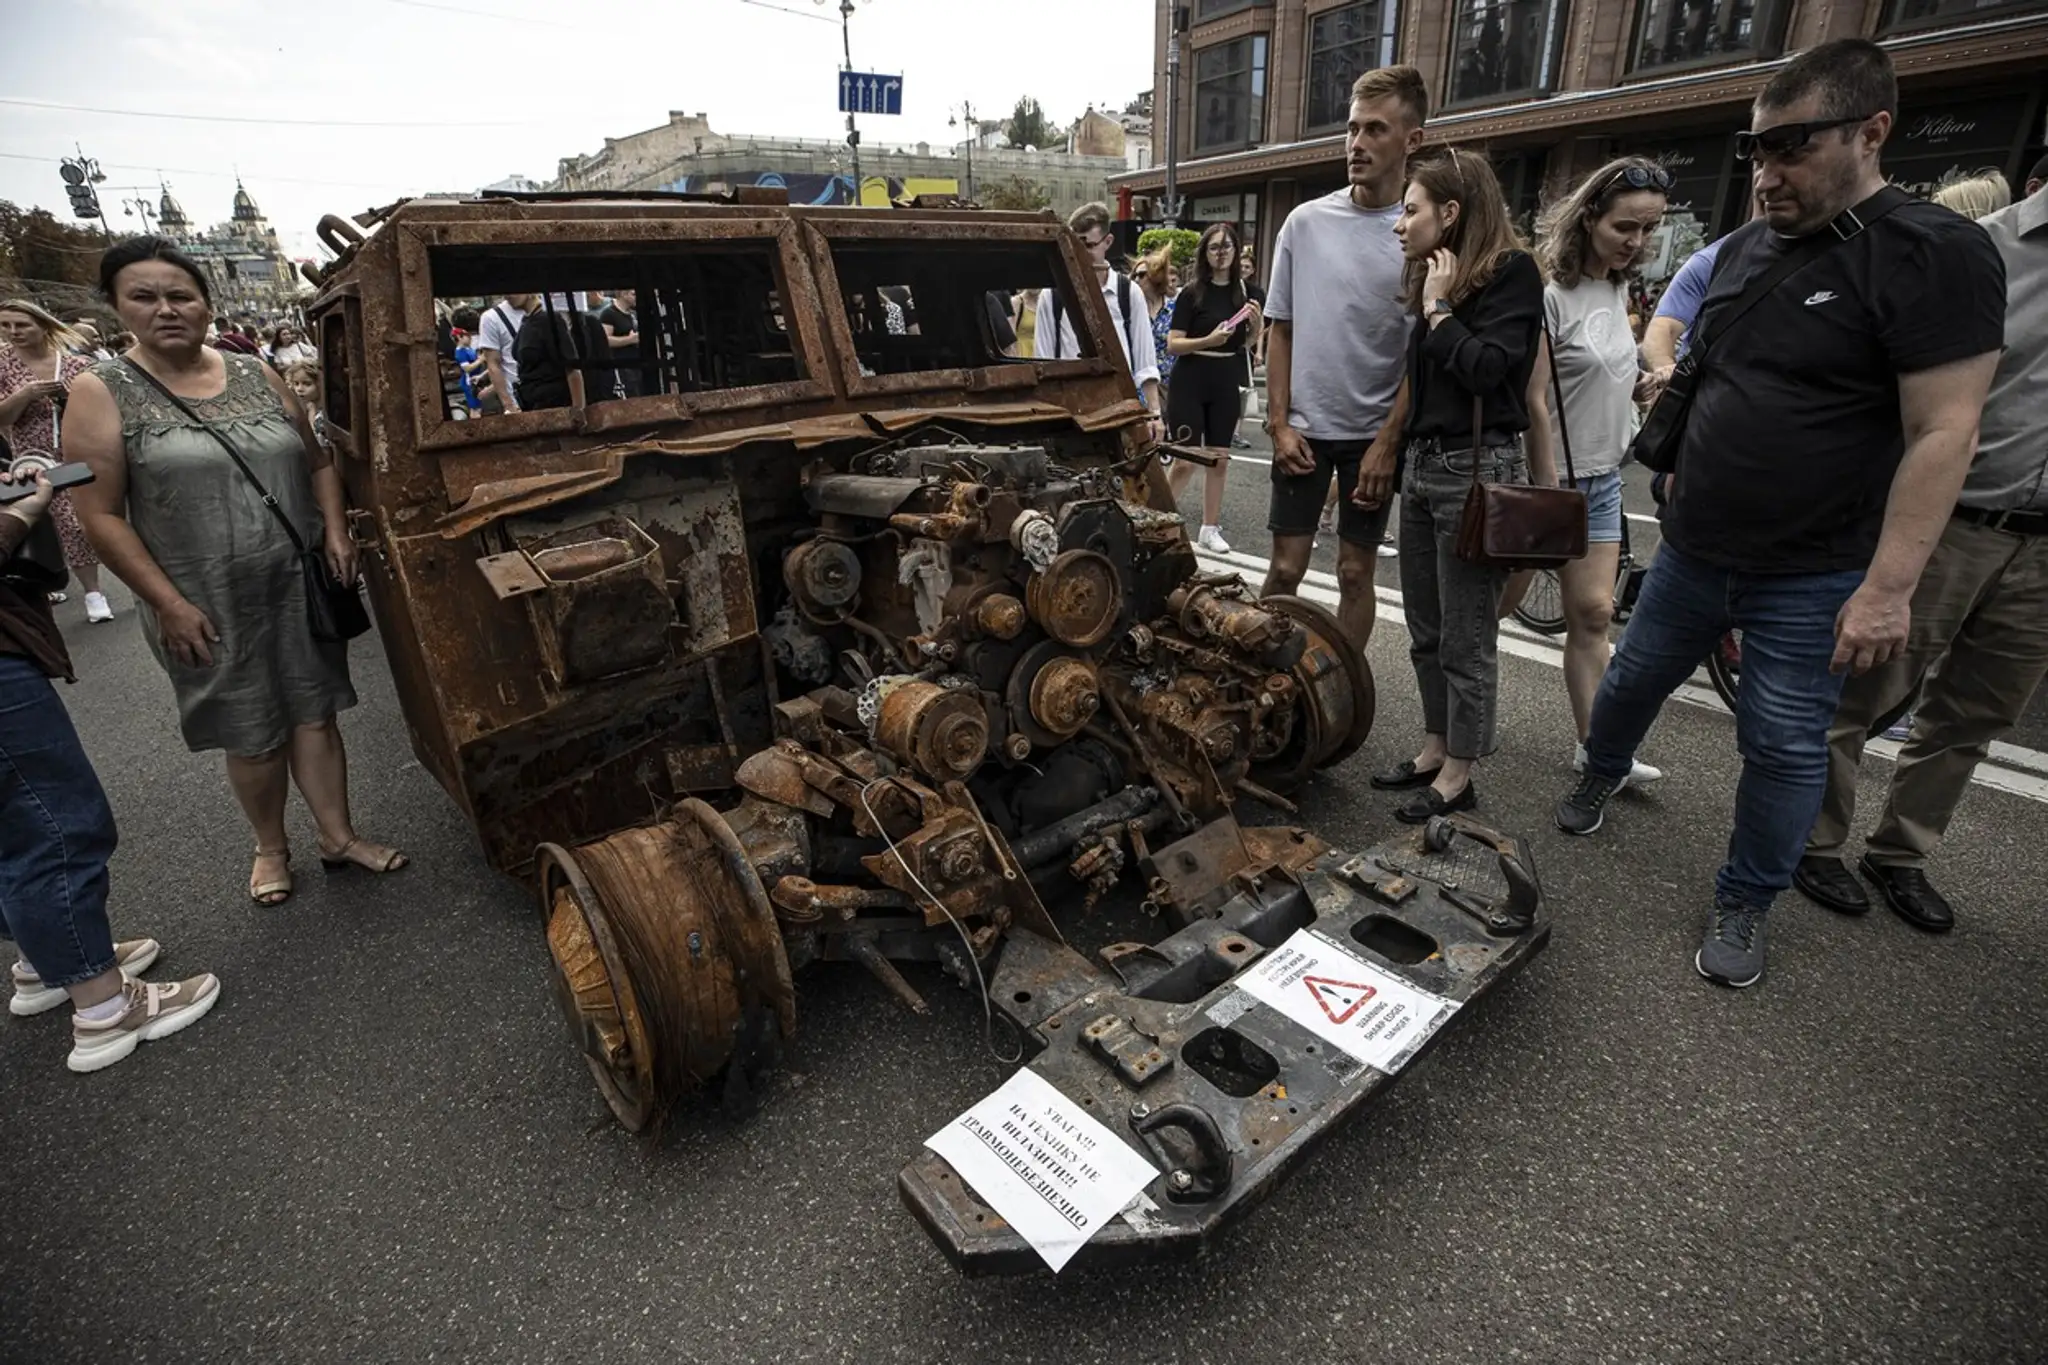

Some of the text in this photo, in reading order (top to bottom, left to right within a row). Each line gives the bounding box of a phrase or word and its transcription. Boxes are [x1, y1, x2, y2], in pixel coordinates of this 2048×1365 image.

[1906, 113, 1976, 139] Kilian
[1202, 204, 1231, 215] CHANEL
[1383, 1015, 1412, 1041] DANGER
[1009, 1103, 1028, 1123] НА
[1079, 1163, 1101, 1183] НЕ
[1044, 1106, 1097, 1151] УВАГА!!!
[963, 1116, 1088, 1229] ТРАВМОНЕБЕЗПЕЧНО
